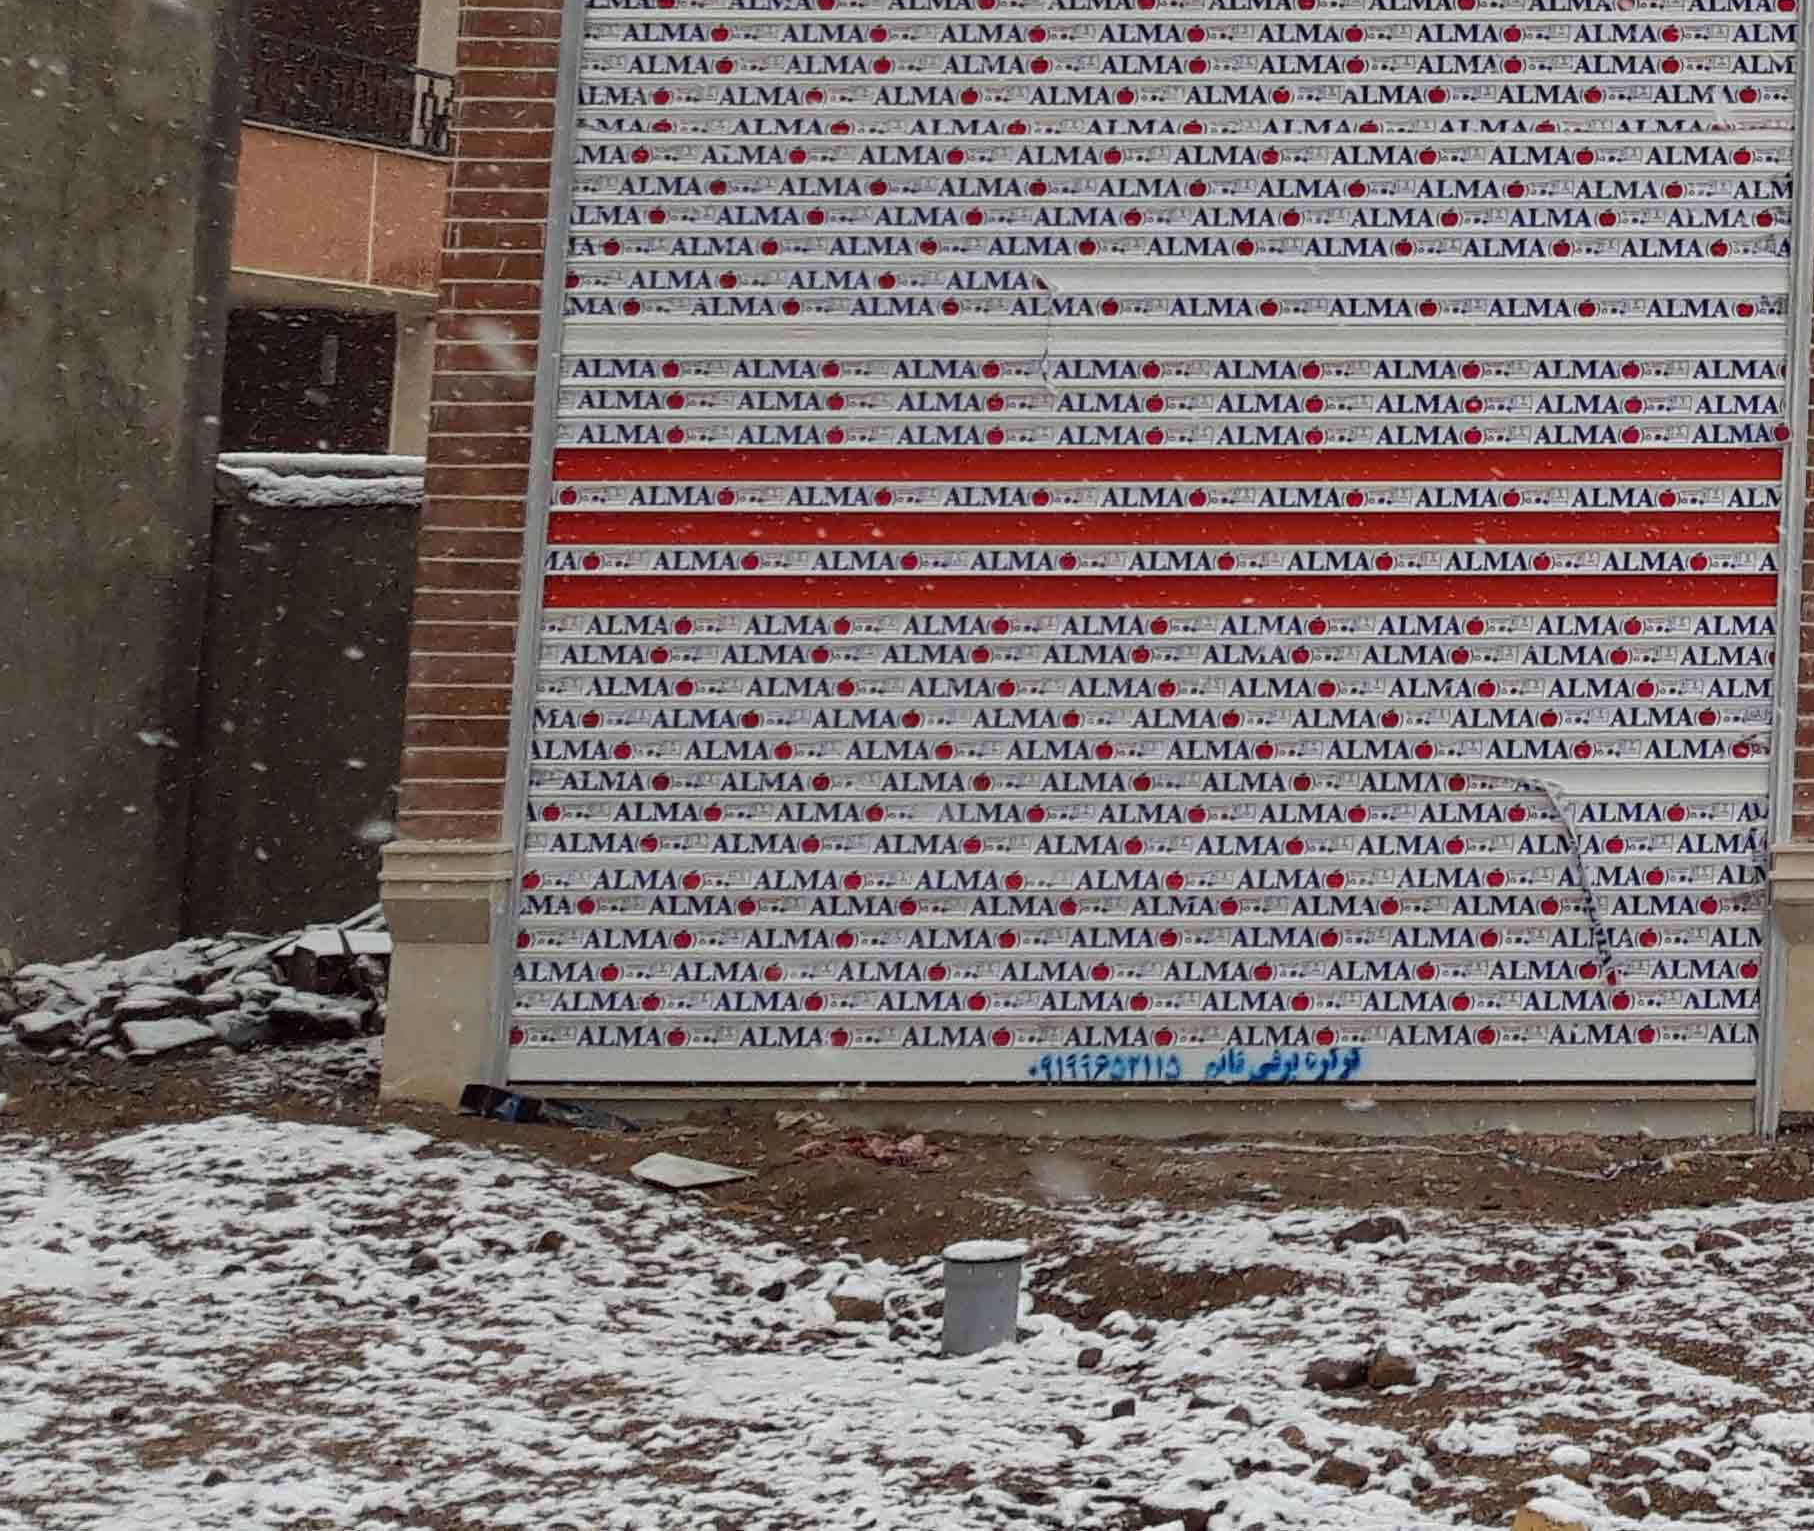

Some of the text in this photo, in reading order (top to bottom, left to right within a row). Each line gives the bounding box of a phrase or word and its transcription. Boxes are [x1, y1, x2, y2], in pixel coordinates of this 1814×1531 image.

[624, 22, 1658, 43] ALMA ALMA ALMA ALMA ALMA ALMA ALMA
[580, 389, 1779, 415] ALMA ALMA ALMA ALMA ALMA ALMA ALMA ALMA
[525, 738, 1725, 761] ALMA ALMA ALMA ALMA ALMA ALMA ALMA ALMA
[550, 989, 1607, 1012] ALMA ALMA ALMA ALMA ALMA ALMA ALMA
